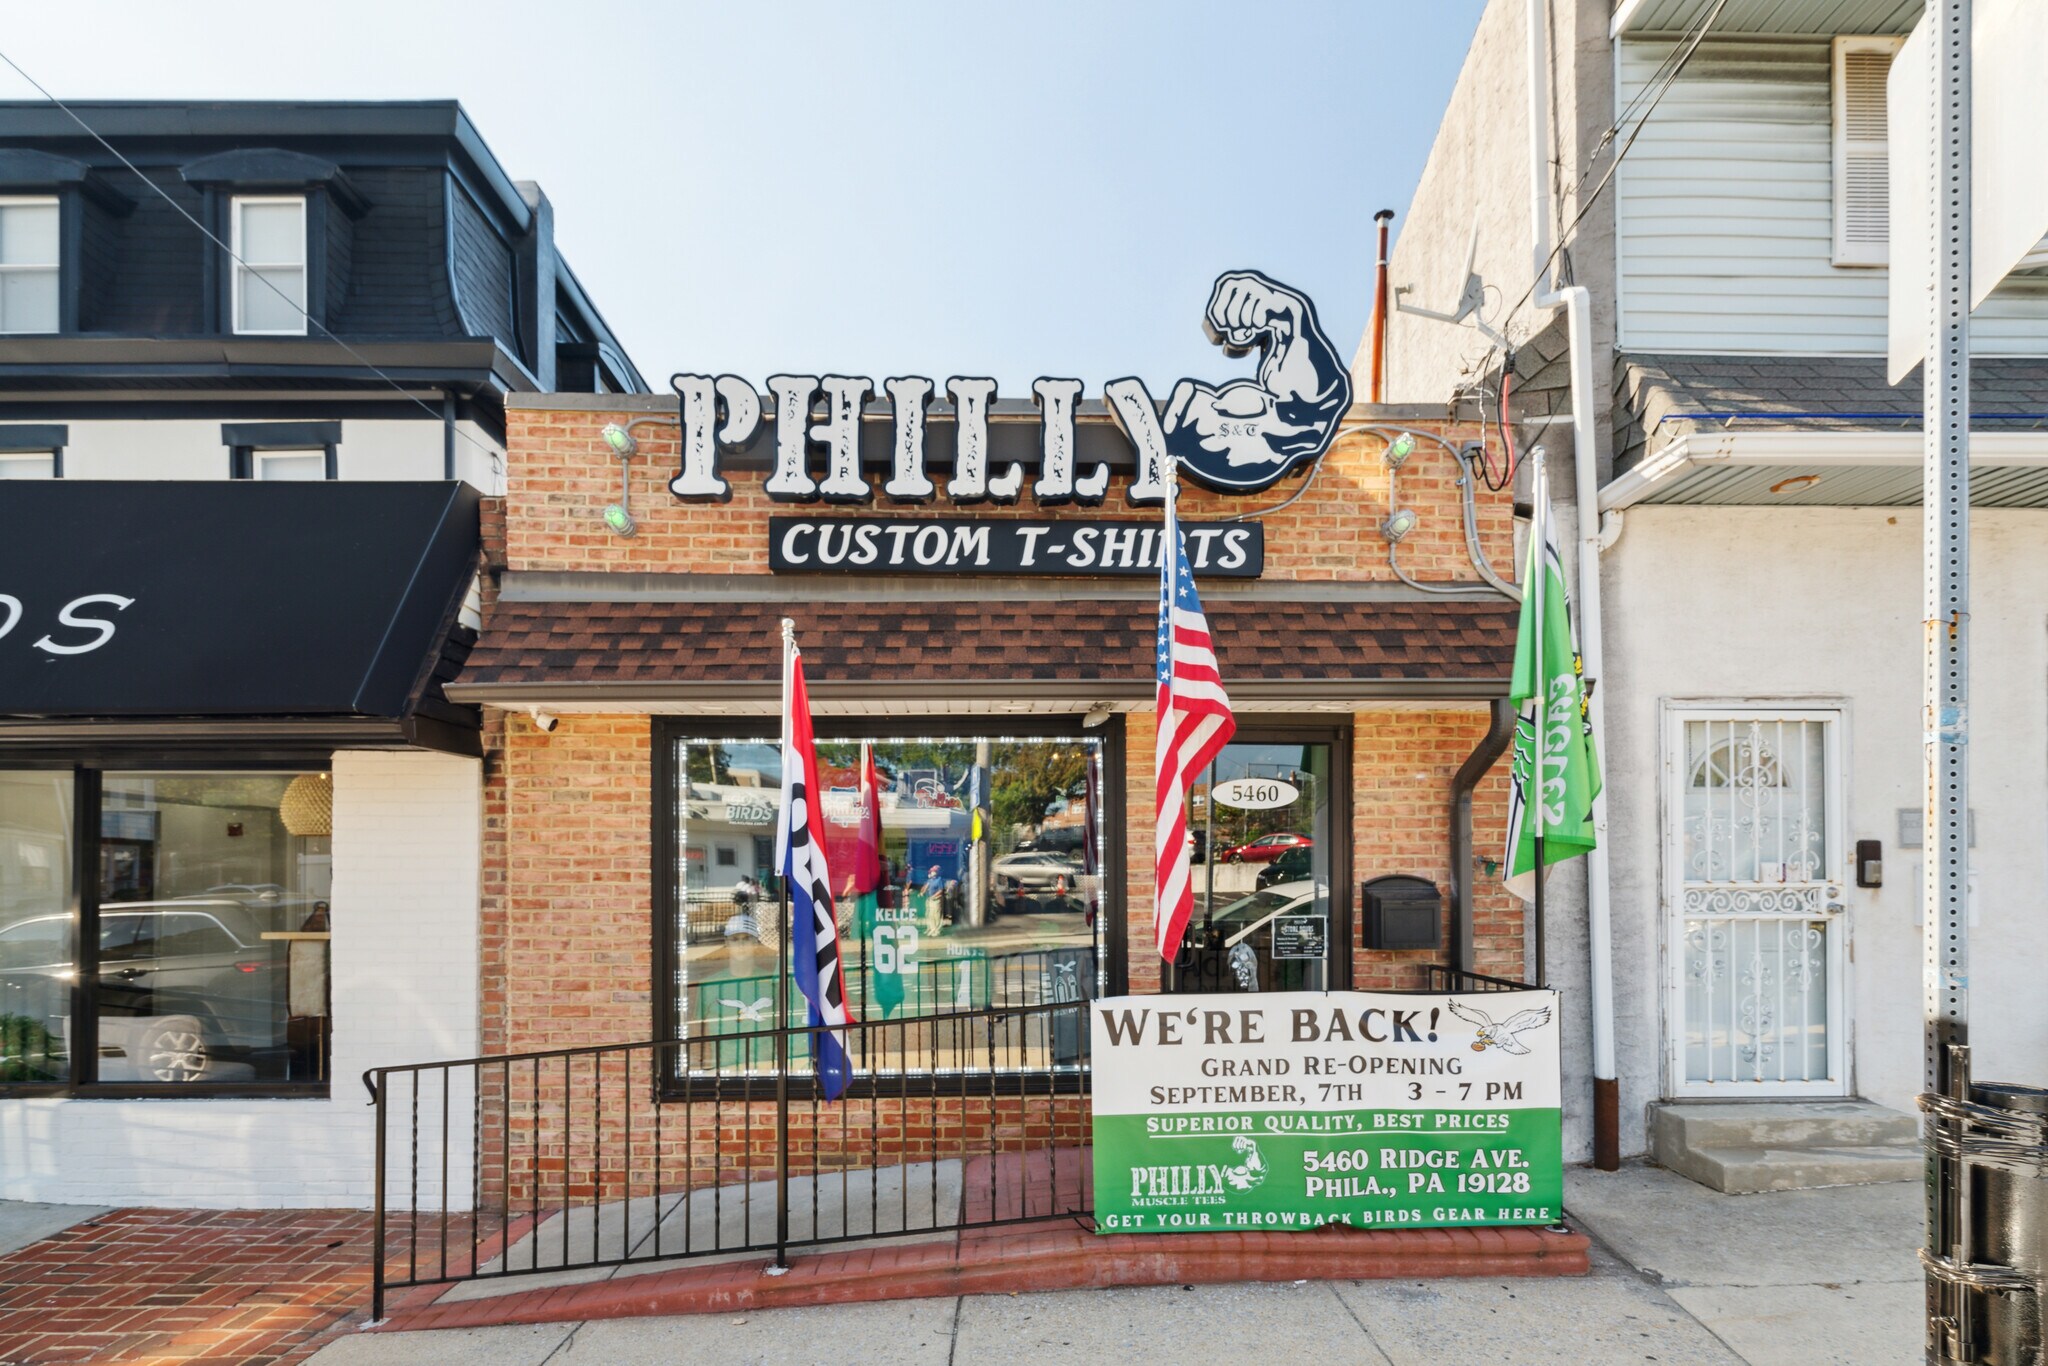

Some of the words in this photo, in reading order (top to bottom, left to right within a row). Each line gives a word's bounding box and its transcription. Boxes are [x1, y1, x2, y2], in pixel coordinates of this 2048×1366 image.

[670, 373, 1197, 500] PHILLY
[781, 523, 992, 565] CUSTOM
[1231, 784, 1279, 802] 5460
[725, 806, 773, 823] BIRDS
[875, 908, 918, 922] KELCE
[873, 925, 919, 974] 62
[1099, 1006, 1265, 1046] WE'RE
[1290, 1007, 1440, 1043] BACK!
[1201, 1058, 1290, 1077] GRAND
[1303, 1055, 1463, 1075] RE-OPENING
[1150, 1085, 1306, 1106] SEPTEMBER,
[1318, 1083, 1363, 1102] 7TH
[1408, 1082, 1423, 1101] 3
[1458, 1082, 1473, 1101] 7
[1486, 1081, 1523, 1101] PM
[1146, 1115, 1254, 1132] SUPERIOR
[1264, 1114, 1363, 1133] QUALITY,
[1373, 1114, 1425, 1129] BEST
[1435, 1113, 1510, 1129] PRICES
[1303, 1150, 1370, 1172] 5460
[1380, 1148, 1460, 1170] RIDGE
[1470, 1148, 1530, 1169] AVE.
[1130, 1164, 1228, 1197] PHILLY
[1305, 1176, 1397, 1198] PHILA.,
[1408, 1172, 1446, 1194] PA
[1458, 1172, 1531, 1194] 19128
[1131, 1197, 1188, 1207] MUSCLE
[1192, 1195, 1226, 1205] TEES
[1106, 1214, 1145, 1228] GET
[1157, 1213, 1211, 1226] YOUR
[1223, 1211, 1352, 1226] THROWBACK
[1363, 1208, 1422, 1224] BIRDS
[1433, 1207, 1486, 1222] GEAR
[1499, 1207, 1549, 1220] HERE
